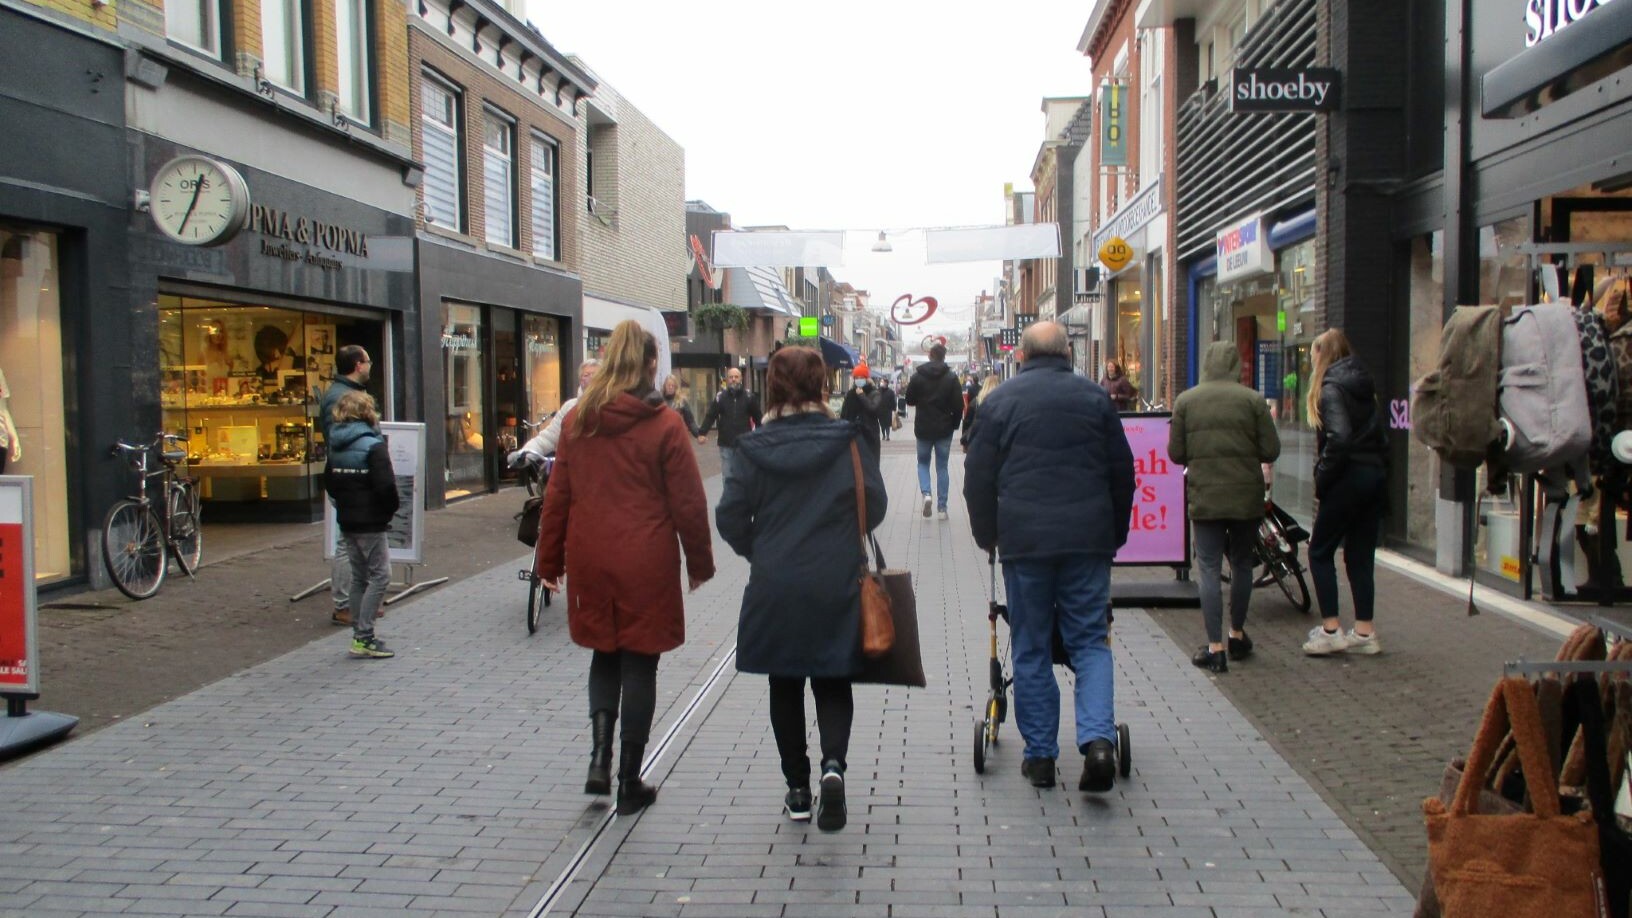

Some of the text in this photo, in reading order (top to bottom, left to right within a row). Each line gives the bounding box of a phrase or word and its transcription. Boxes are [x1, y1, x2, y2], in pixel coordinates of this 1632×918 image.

[1237, 72, 1331, 106] shoeby
[180, 179, 210, 190] ORS
[242, 202, 369, 258] PMA & POPMA
